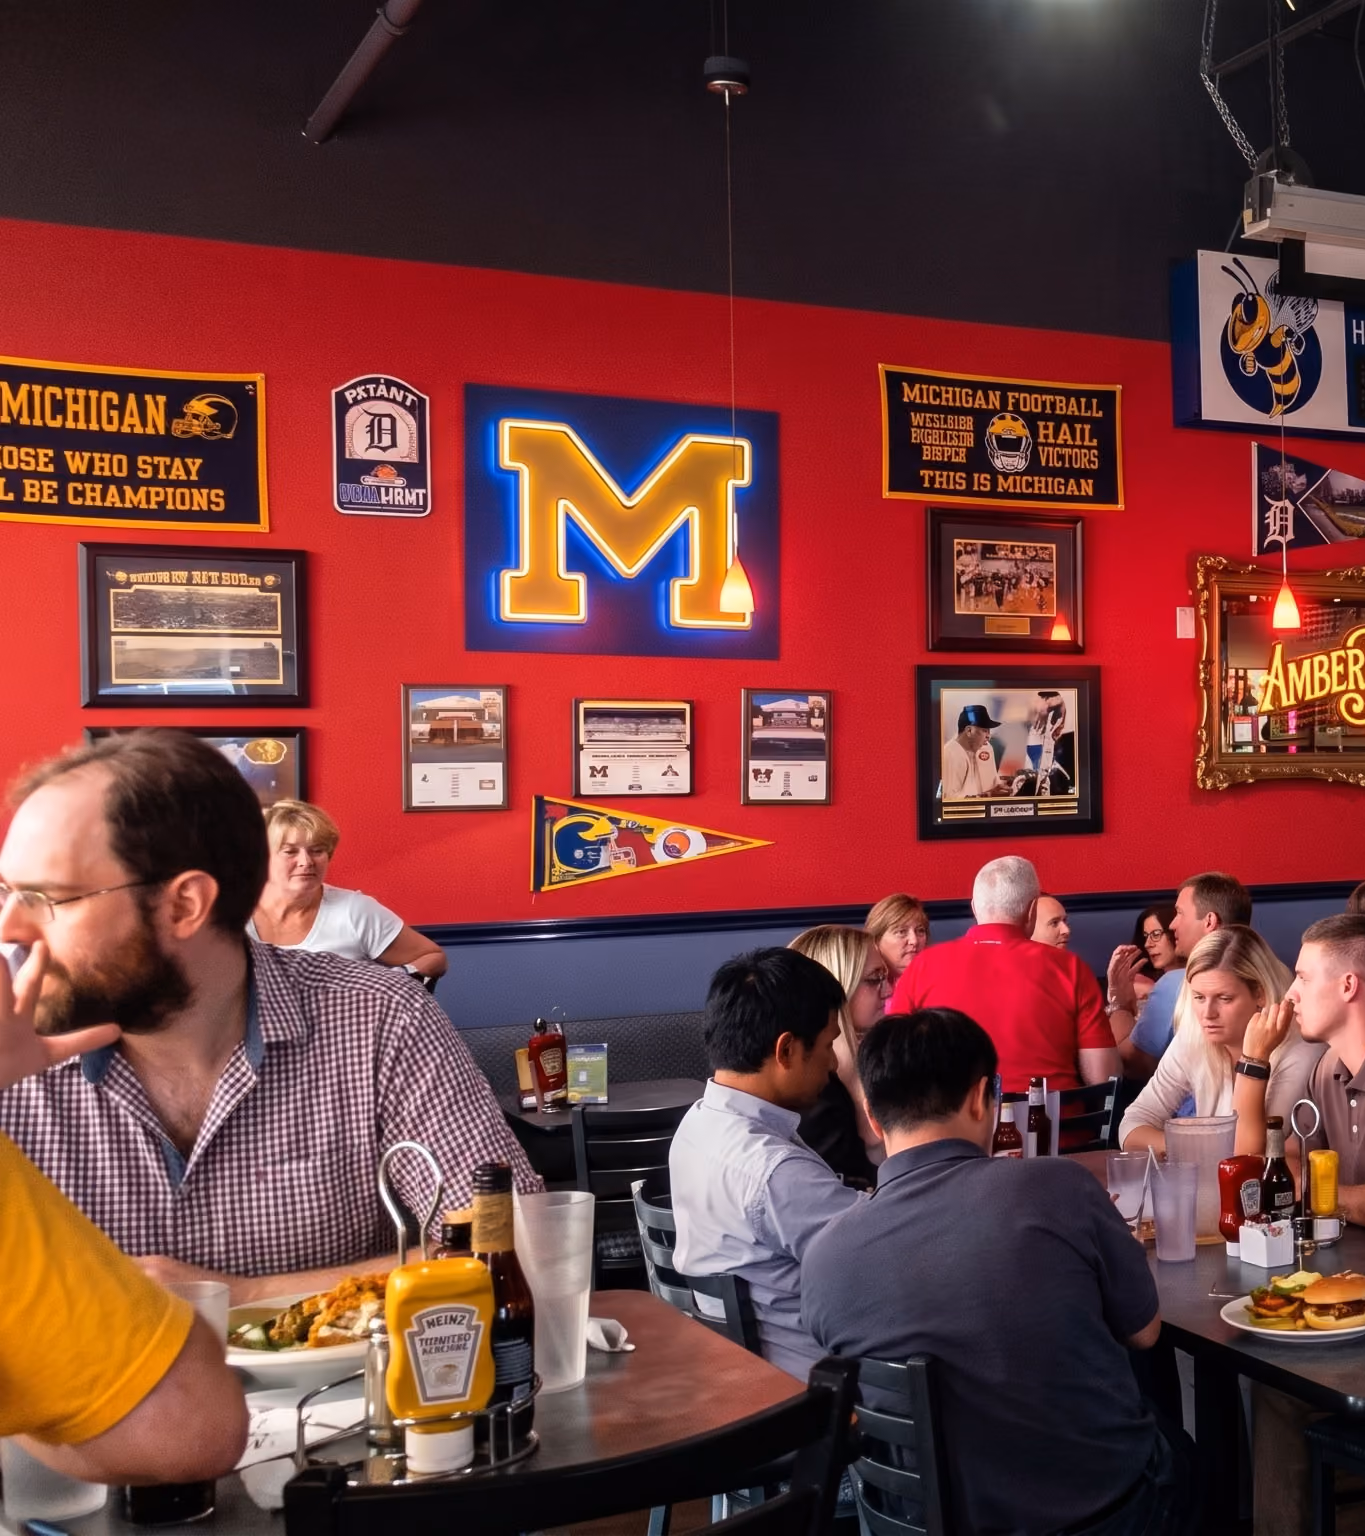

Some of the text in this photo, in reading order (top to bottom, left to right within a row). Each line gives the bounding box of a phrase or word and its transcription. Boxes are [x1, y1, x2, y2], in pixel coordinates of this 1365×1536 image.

[0, 381, 167, 435] MICHIGAN
[902, 382, 1103, 417] MICHIGAN FOOTBALL
[365, 408, 398, 453] D
[1037, 420, 1098, 446] HAIL
[64, 450, 128, 477] WHO
[137, 455, 203, 481] STAY
[1039, 447, 1099, 469] VICTORS
[23, 478, 58, 504] BE
[67, 482, 226, 512] CHAMPIONS
[920, 470, 1094, 496] THIS IS MICHIGAN
[500, 418, 752, 630] M
[1263, 494, 1296, 549] D
[588, 766, 609, 778] M
